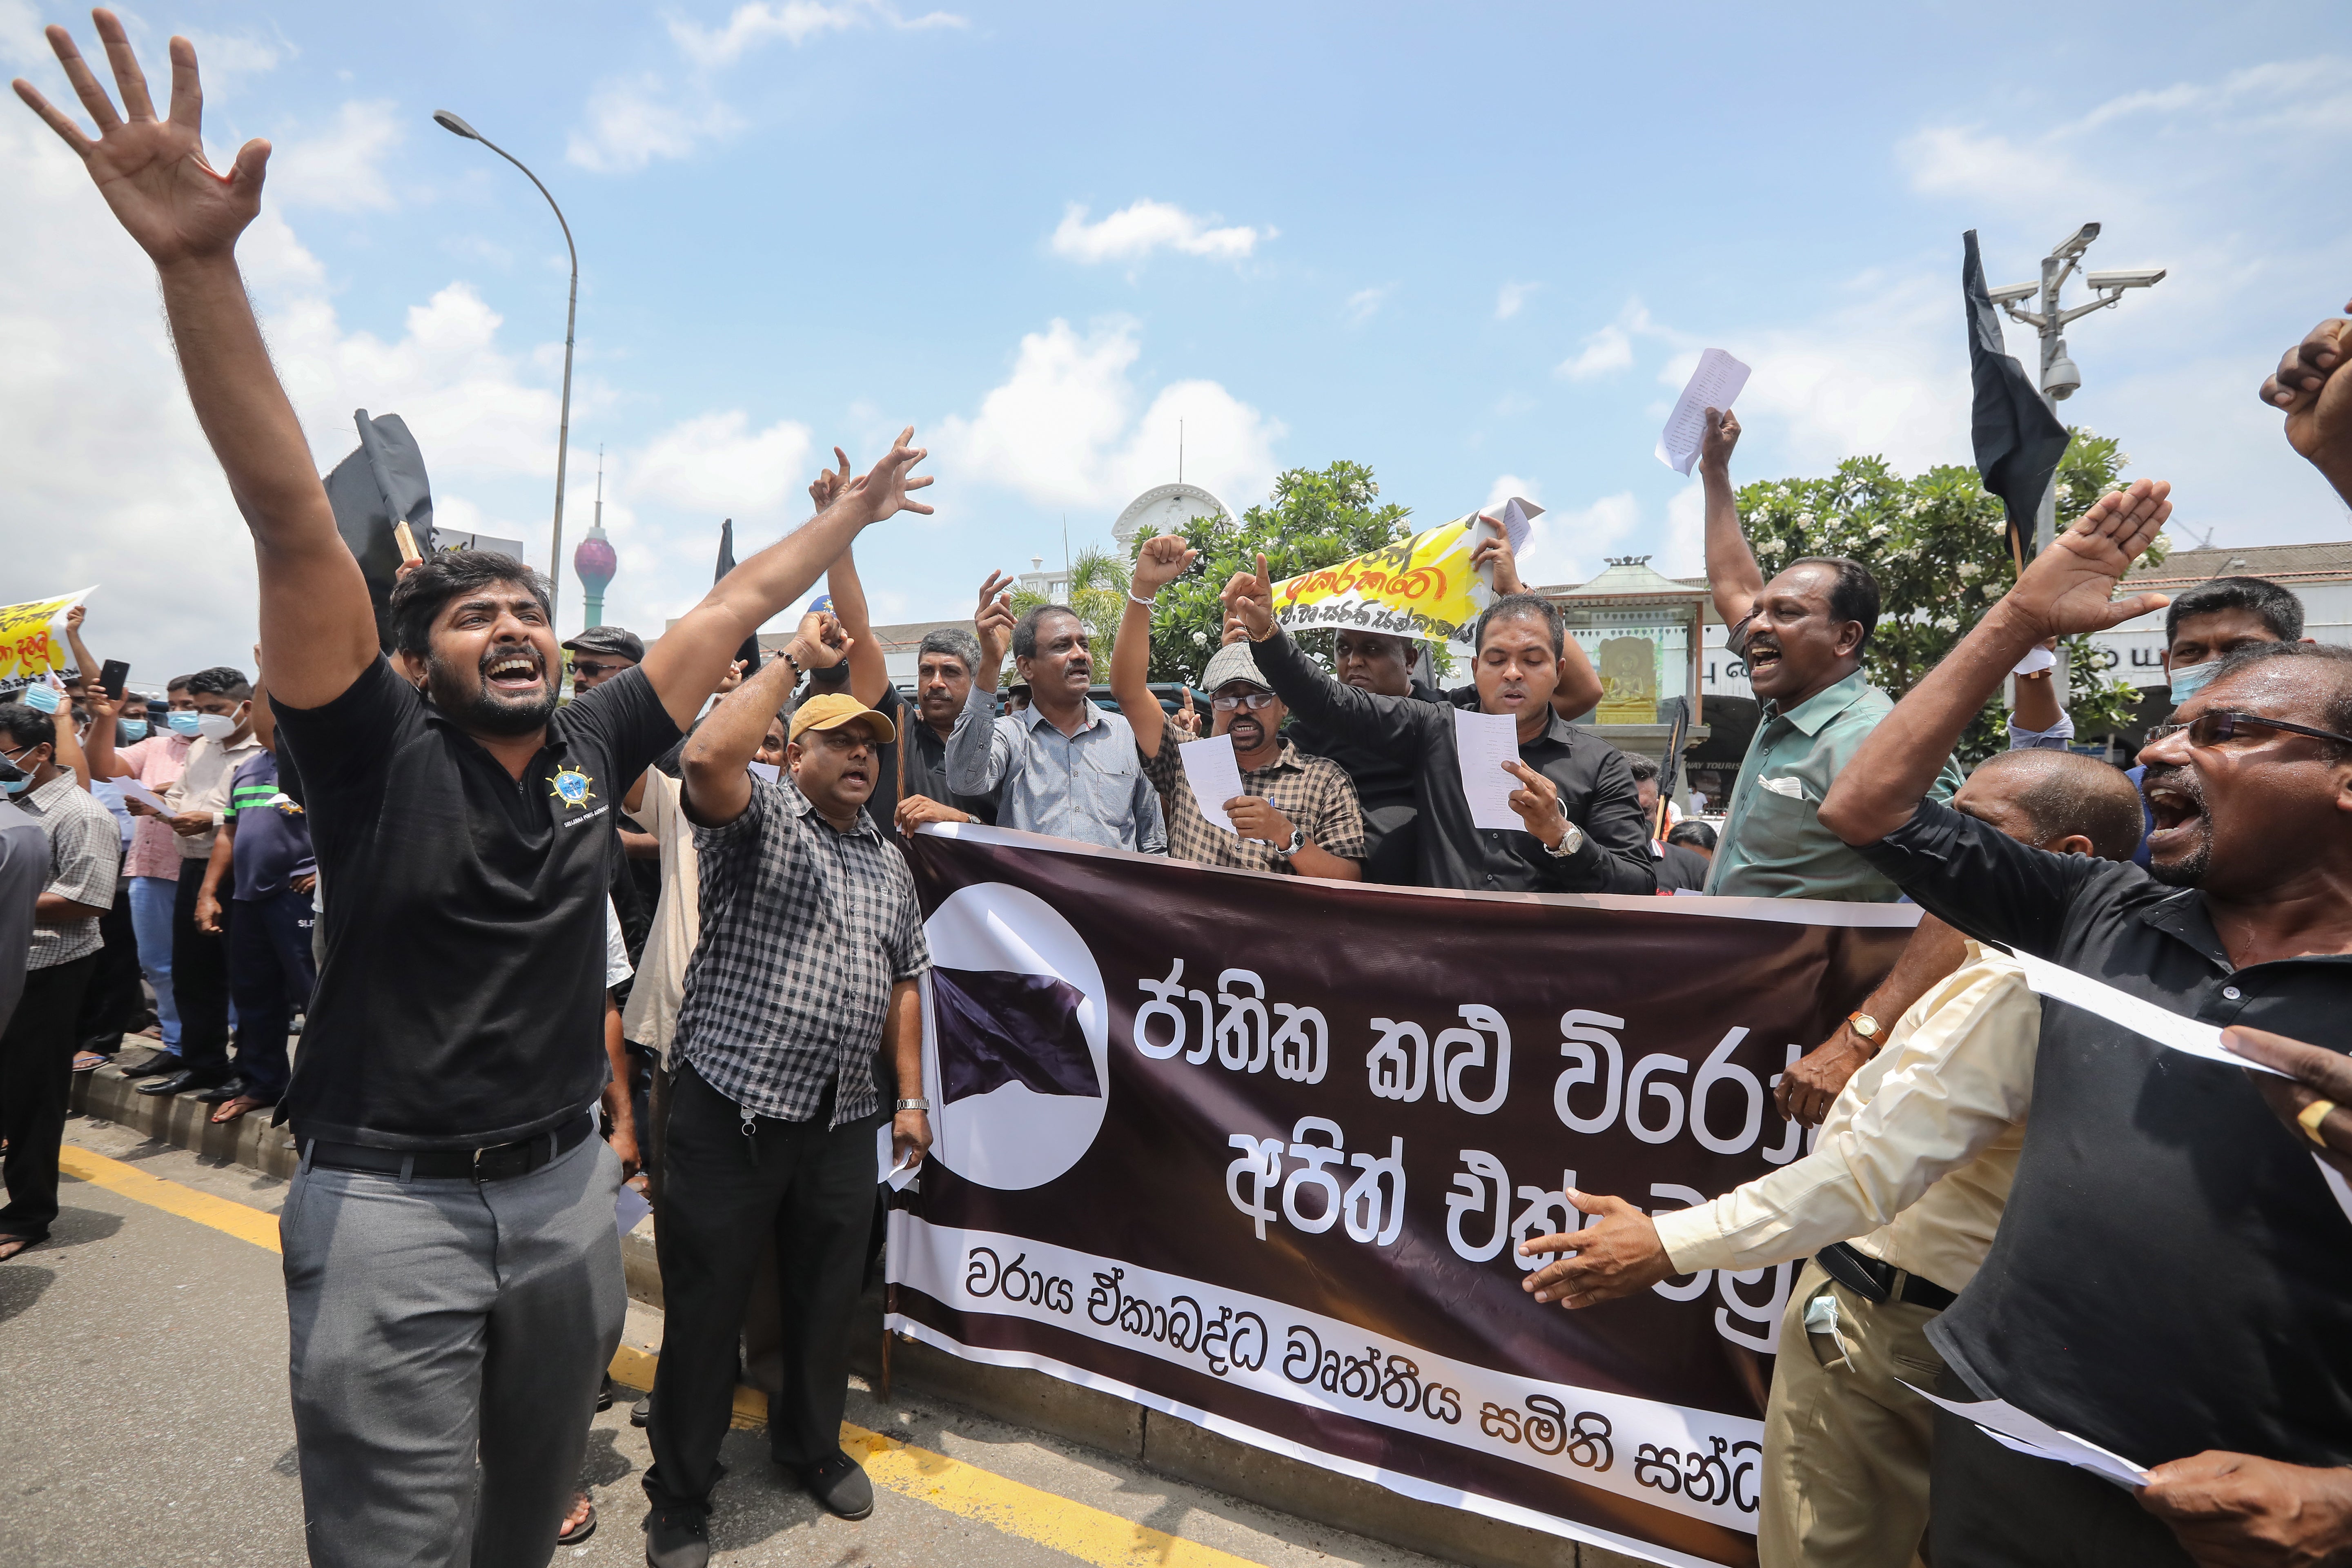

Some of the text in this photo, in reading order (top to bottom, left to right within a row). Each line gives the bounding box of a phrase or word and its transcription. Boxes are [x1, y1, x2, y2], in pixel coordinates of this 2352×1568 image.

[571, 816, 584, 825] LANKA
[583, 811, 594, 820] PORTS
[1134, 958, 1821, 1165] ජාතික කළු විරෝ
[1226, 1116, 1406, 1247] අපිත්
[965, 1247, 1074, 1315] වරාය
[1087, 1267, 1268, 1376] ඒකාබද්ධ
[1282, 1325, 1462, 1425] වෘත්තීය
[1479, 1394, 1615, 1472] සමිති
